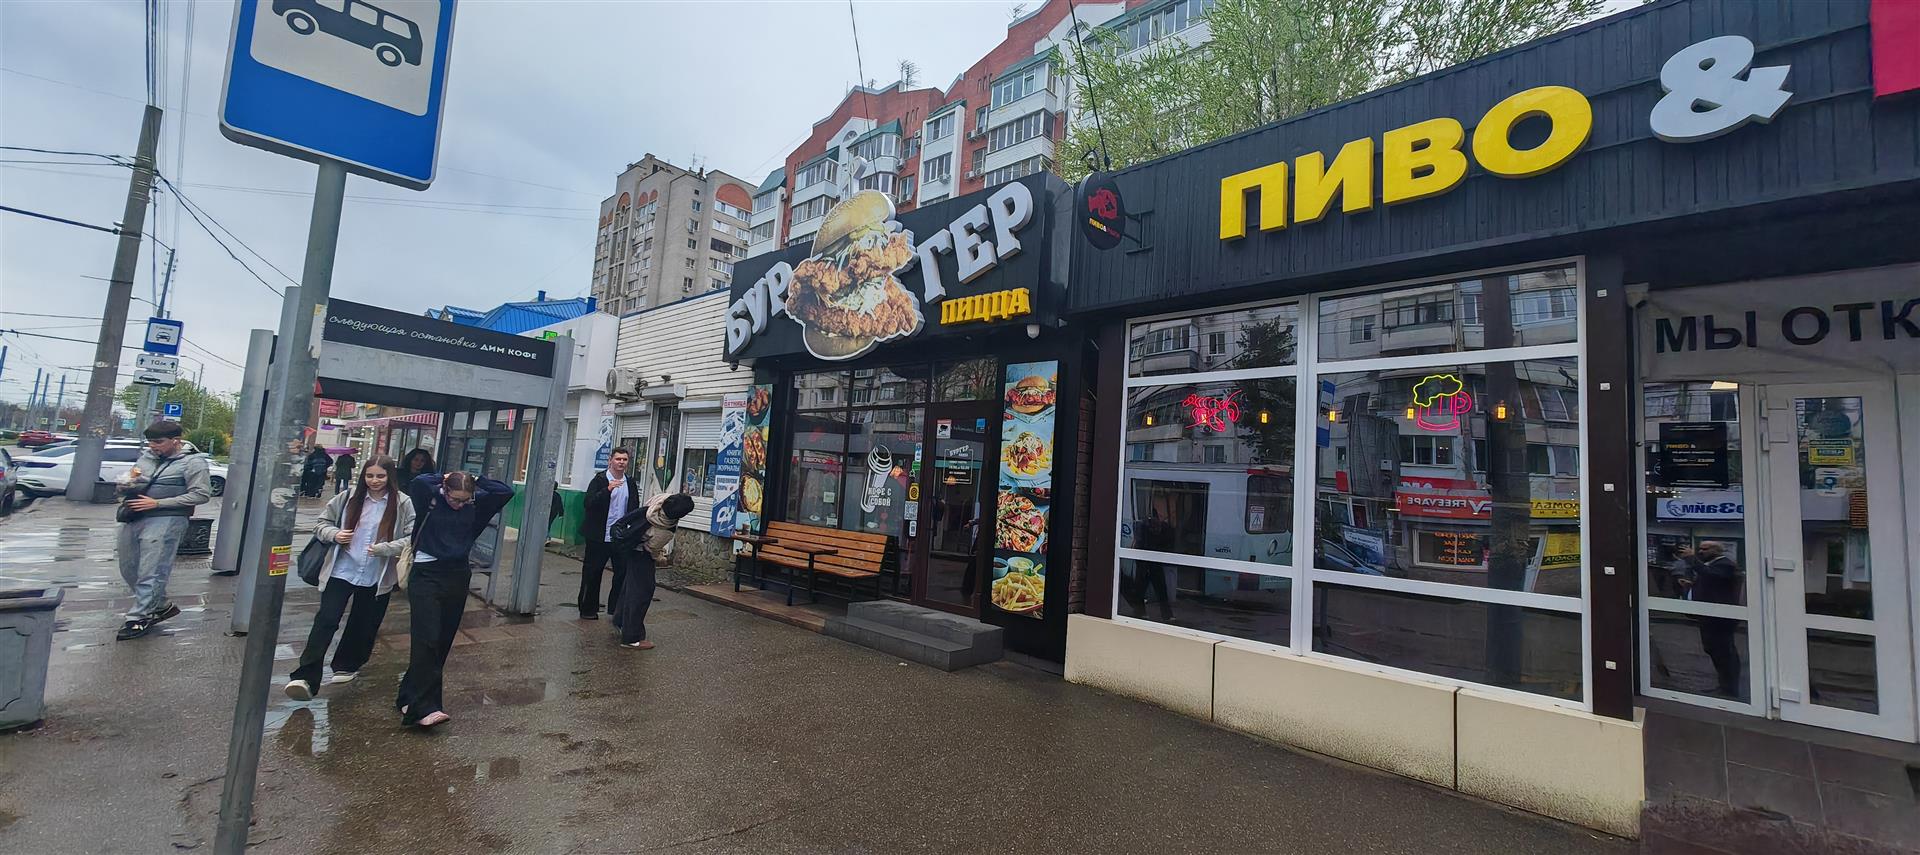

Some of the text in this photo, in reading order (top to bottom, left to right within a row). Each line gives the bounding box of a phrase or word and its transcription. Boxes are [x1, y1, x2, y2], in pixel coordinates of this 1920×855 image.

[1219, 35, 1794, 241] ПИВО &
[725, 181, 1034, 355] БУР ГЕР
[939, 287, 1032, 326] ПИЦЦА
[410, 329, 479, 350] остановка
[479, 342, 506, 355] ДИМ
[507, 347, 538, 361] КОФЕ
[1655, 311, 1758, 354] МЫ
[867, 487, 892, 496] КОФЕ С
[869, 496, 892, 507] СОБОЙ
